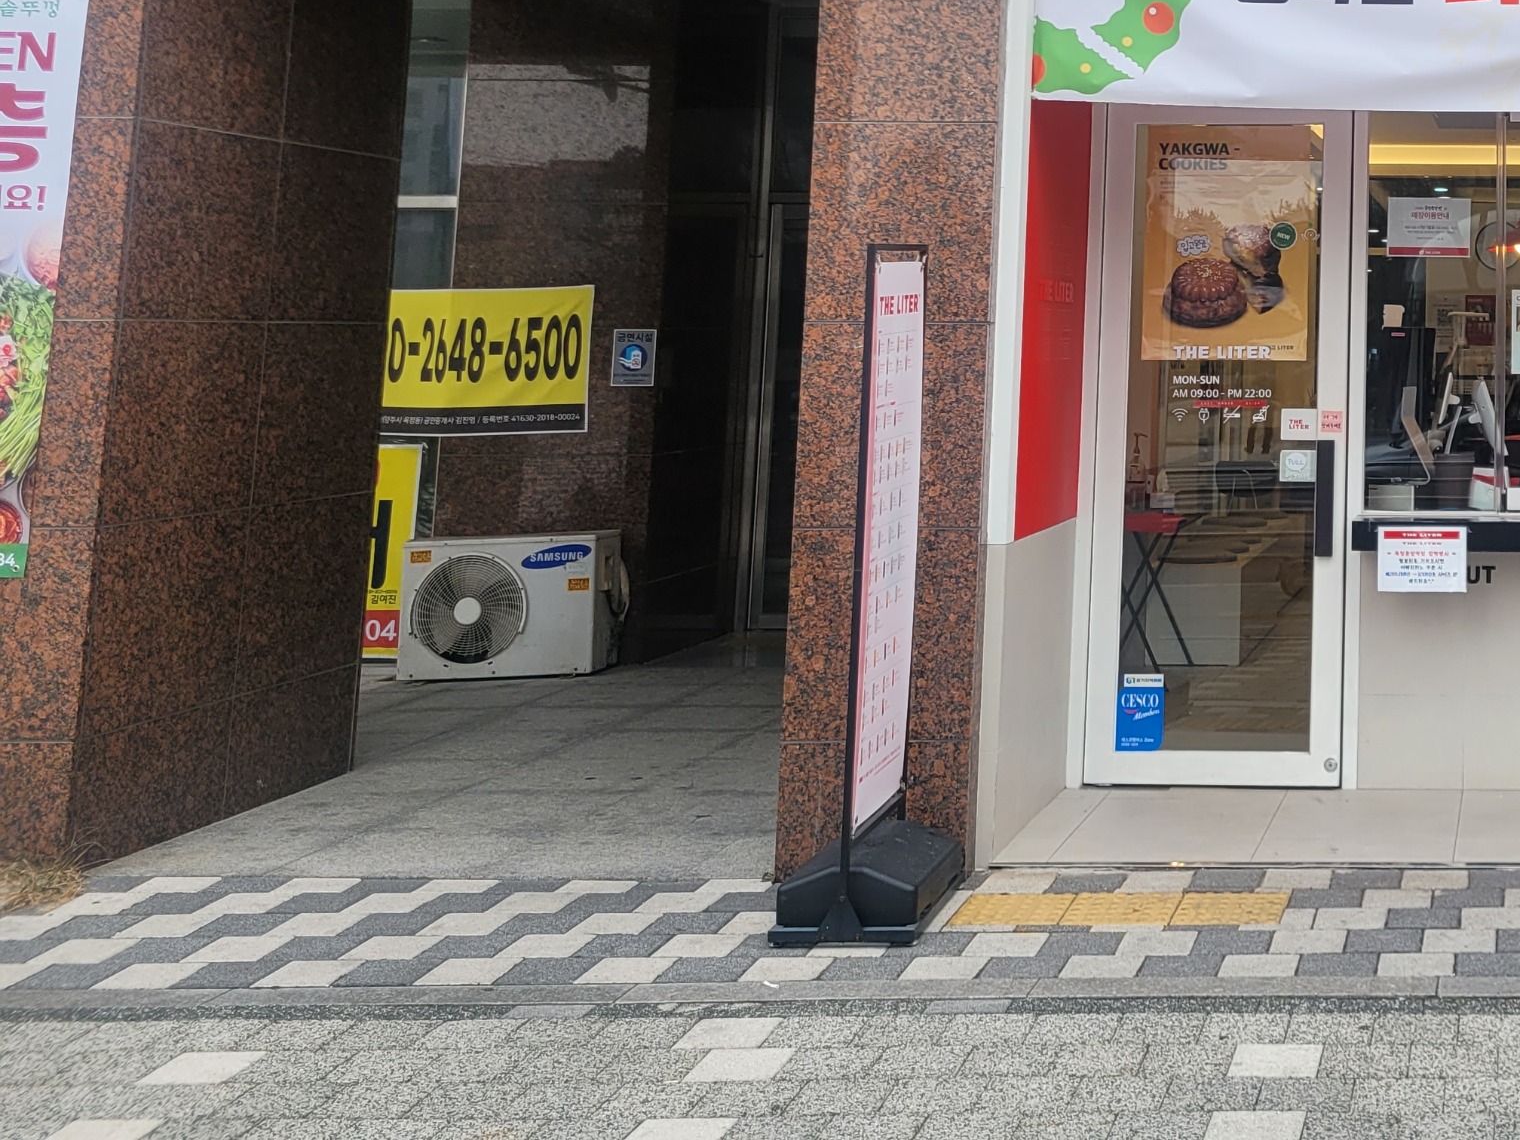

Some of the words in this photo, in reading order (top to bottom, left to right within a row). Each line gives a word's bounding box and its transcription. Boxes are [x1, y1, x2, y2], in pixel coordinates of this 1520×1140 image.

[1159, 142, 1229, 156] YAKGWA
[1159, 158, 1227, 171] COOKIES
[1276, 231, 1291, 240] NEW
[880, 295, 894, 315] THE
[897, 293, 919, 314] LITER
[617, 333, 653, 342] 금연시설
[1173, 345, 1209, 359] THE
[1216, 345, 1271, 359] LITER
[1173, 376, 1220, 385] MON-SUN
[1173, 389, 1188, 398] AM
[1190, 389, 1219, 398] 09:00
[1228, 389, 1242, 398] PM
[1245, 389, 1271, 398] 22:00
[530, 552, 584, 563] SAMSUNG
[371, 595, 397, 605] 김여진
[366, 619, 397, 641] 04
[1121, 693, 1159, 708] CESCO
